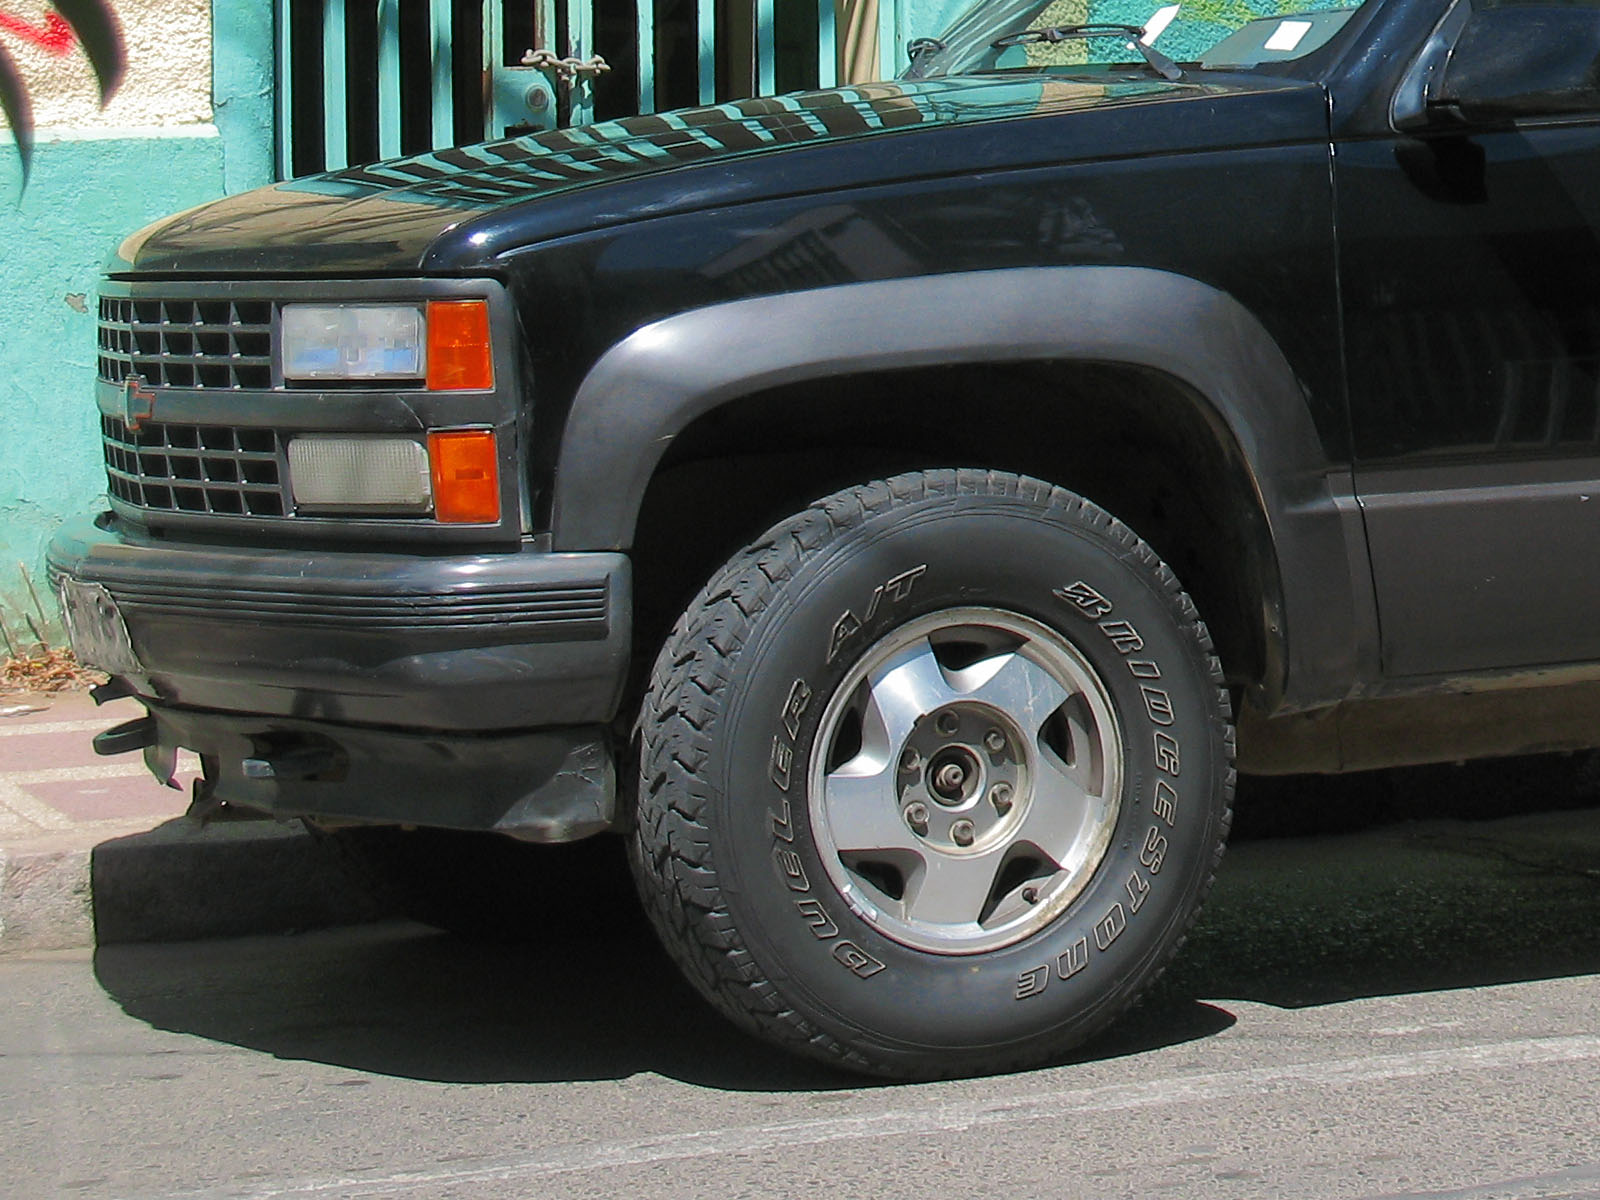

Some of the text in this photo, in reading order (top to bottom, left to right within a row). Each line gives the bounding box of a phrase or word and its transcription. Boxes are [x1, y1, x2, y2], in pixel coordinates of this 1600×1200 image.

[768, 563, 928, 980] DUELER A/T
[1016, 580, 1180, 1001] BRIDGESTONE
